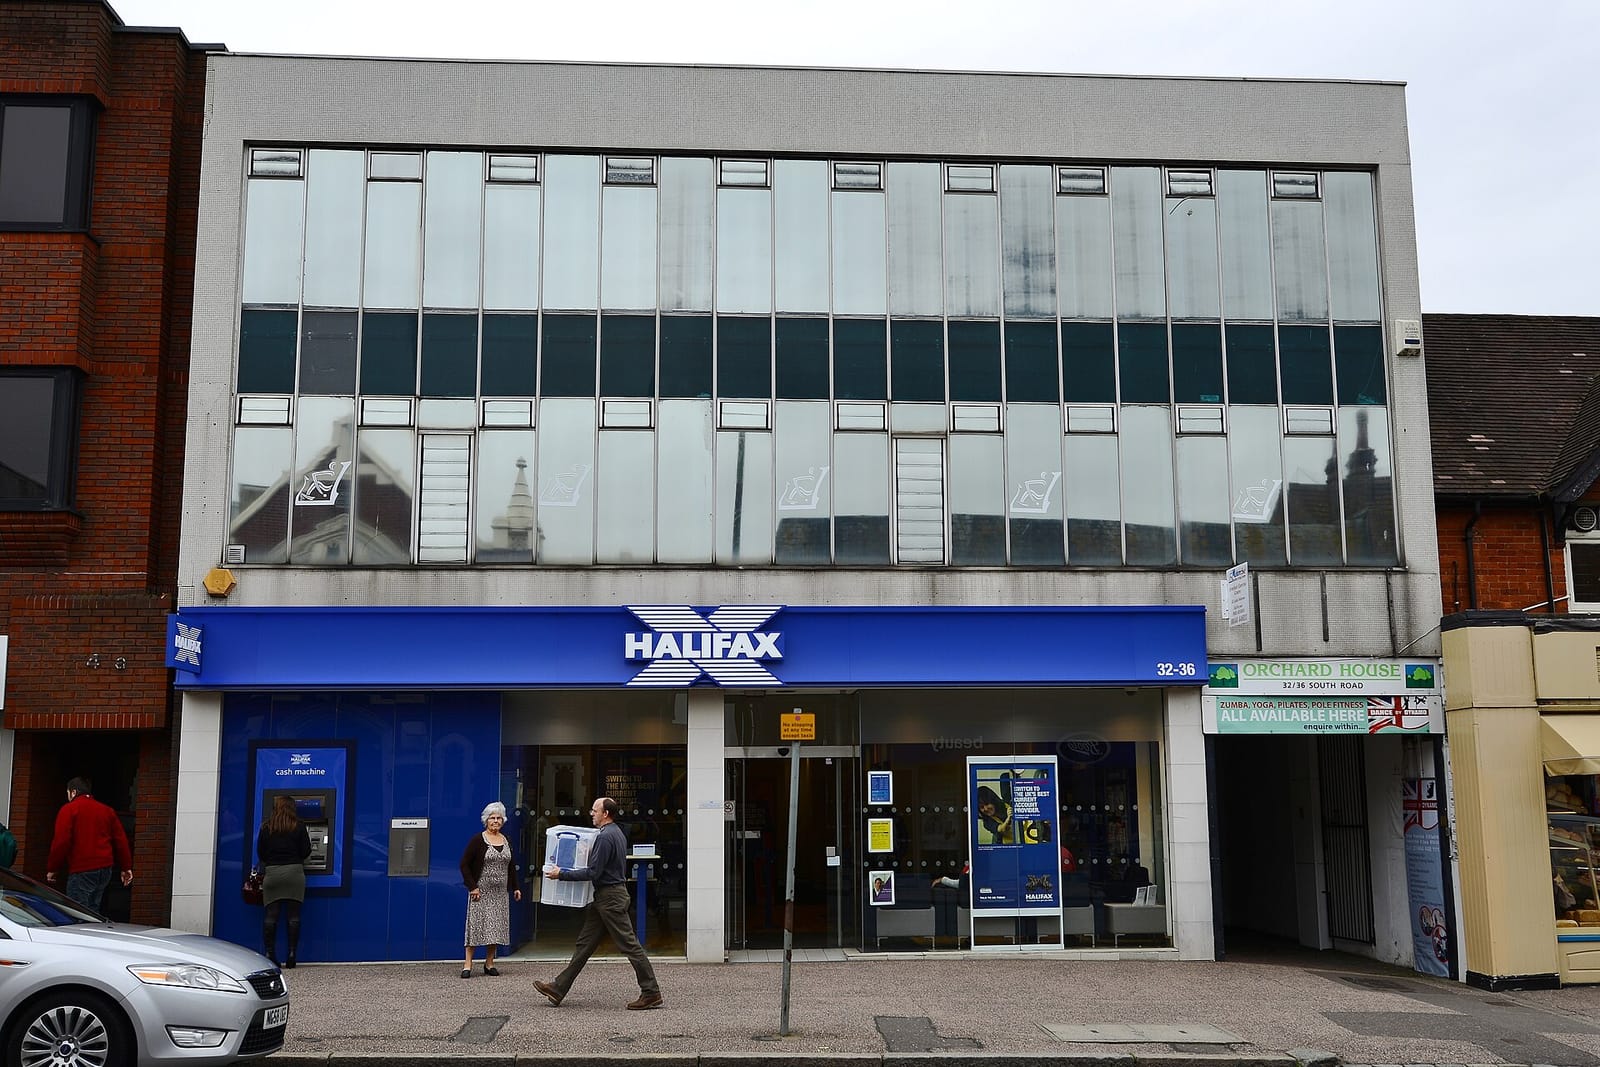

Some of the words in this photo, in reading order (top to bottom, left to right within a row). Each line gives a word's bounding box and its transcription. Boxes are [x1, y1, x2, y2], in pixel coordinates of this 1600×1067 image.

[175, 635, 201, 654] HALIFAX
[625, 632, 783, 659] HALIFAX
[1156, 662, 1196, 676] 32-36
[1242, 663, 1332, 677] ORCHARD
[1340, 663, 1401, 678] HOUSE
[1282, 681, 1306, 690] 32/36
[1309, 681, 1337, 689] SOUTH
[1340, 681, 1364, 689] ROAD
[1220, 701, 1251, 710] ZUMBA,
[1252, 701, 1277, 710] YOGA,
[1277, 701, 1310, 710] PILATES,
[1311, 701, 1332, 709] POLE
[1332, 701, 1364, 709] FITNESS
[1221, 709, 1247, 722] ALL
[1249, 709, 1326, 722] AVAILABLE
[1328, 709, 1365, 721] HERE
[1303, 723, 1333, 732] enquire
[275, 768, 293, 776] cash
[294, 768, 326, 776] machine
